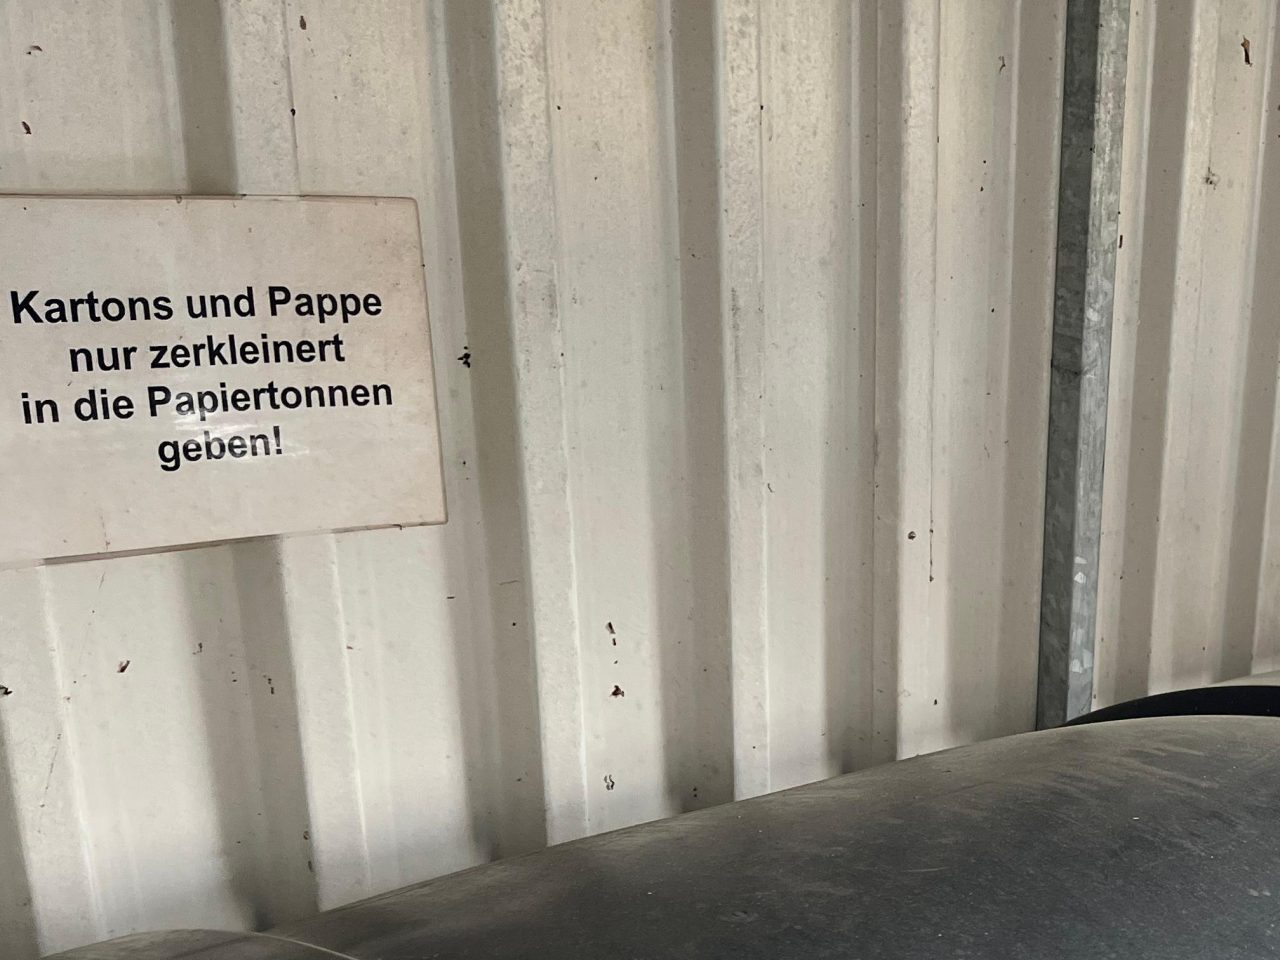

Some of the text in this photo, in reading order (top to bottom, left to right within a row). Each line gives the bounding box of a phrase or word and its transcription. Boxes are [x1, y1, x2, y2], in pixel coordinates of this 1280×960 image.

[10, 285, 383, 325] Kartons und Pappe
[69, 333, 346, 373] nur zerkleinert
[21, 381, 393, 425] in die Papiertonnen
[158, 425, 284, 472] geben!
